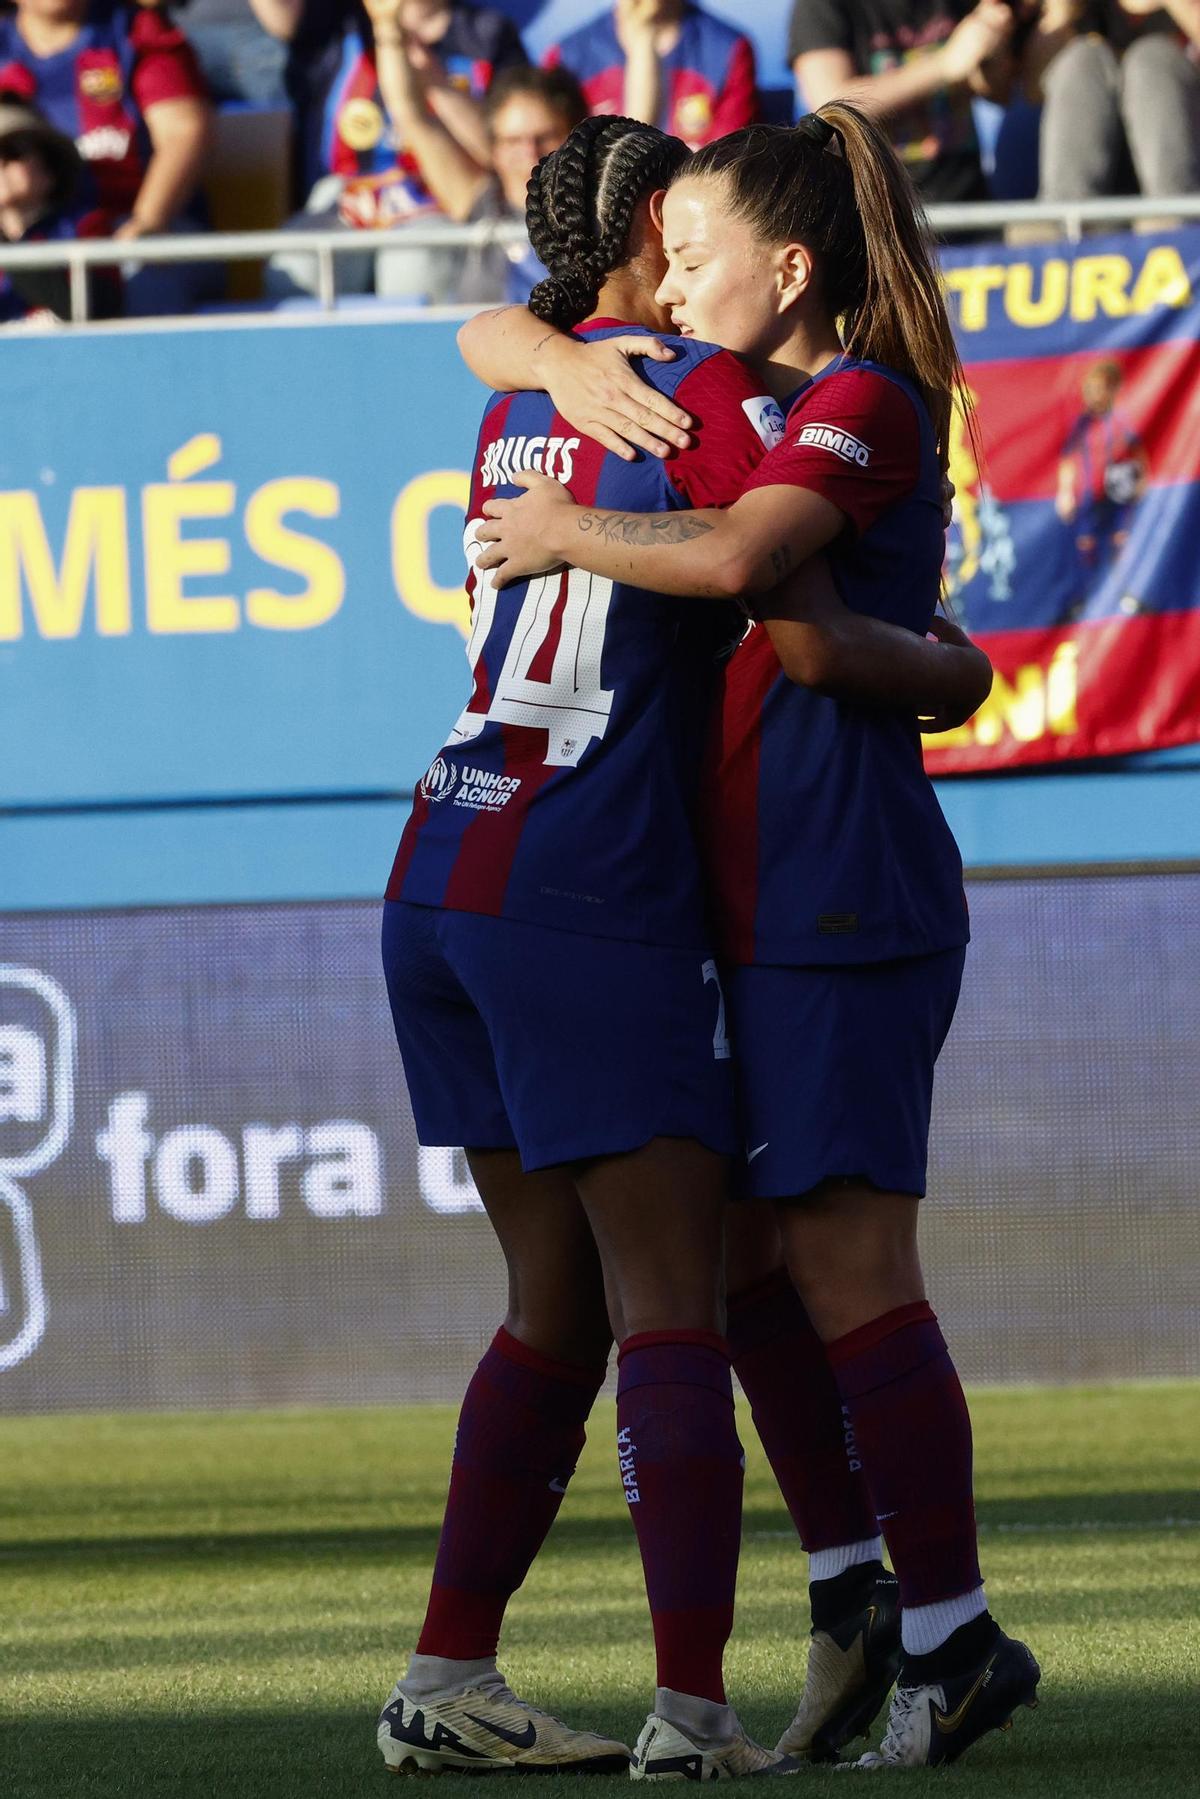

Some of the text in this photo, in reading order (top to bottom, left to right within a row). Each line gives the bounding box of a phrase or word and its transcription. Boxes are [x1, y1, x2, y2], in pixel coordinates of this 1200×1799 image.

[936, 246, 1191, 331] TURA
[799, 427, 869, 467] BIMBO
[0, 433, 345, 640] MÉS
[455, 784, 512, 806] ACNUR
[461, 766, 521, 793] UNHCR
[97, 1091, 384, 1225] fora
[617, 1426, 640, 1503] BARÇA
